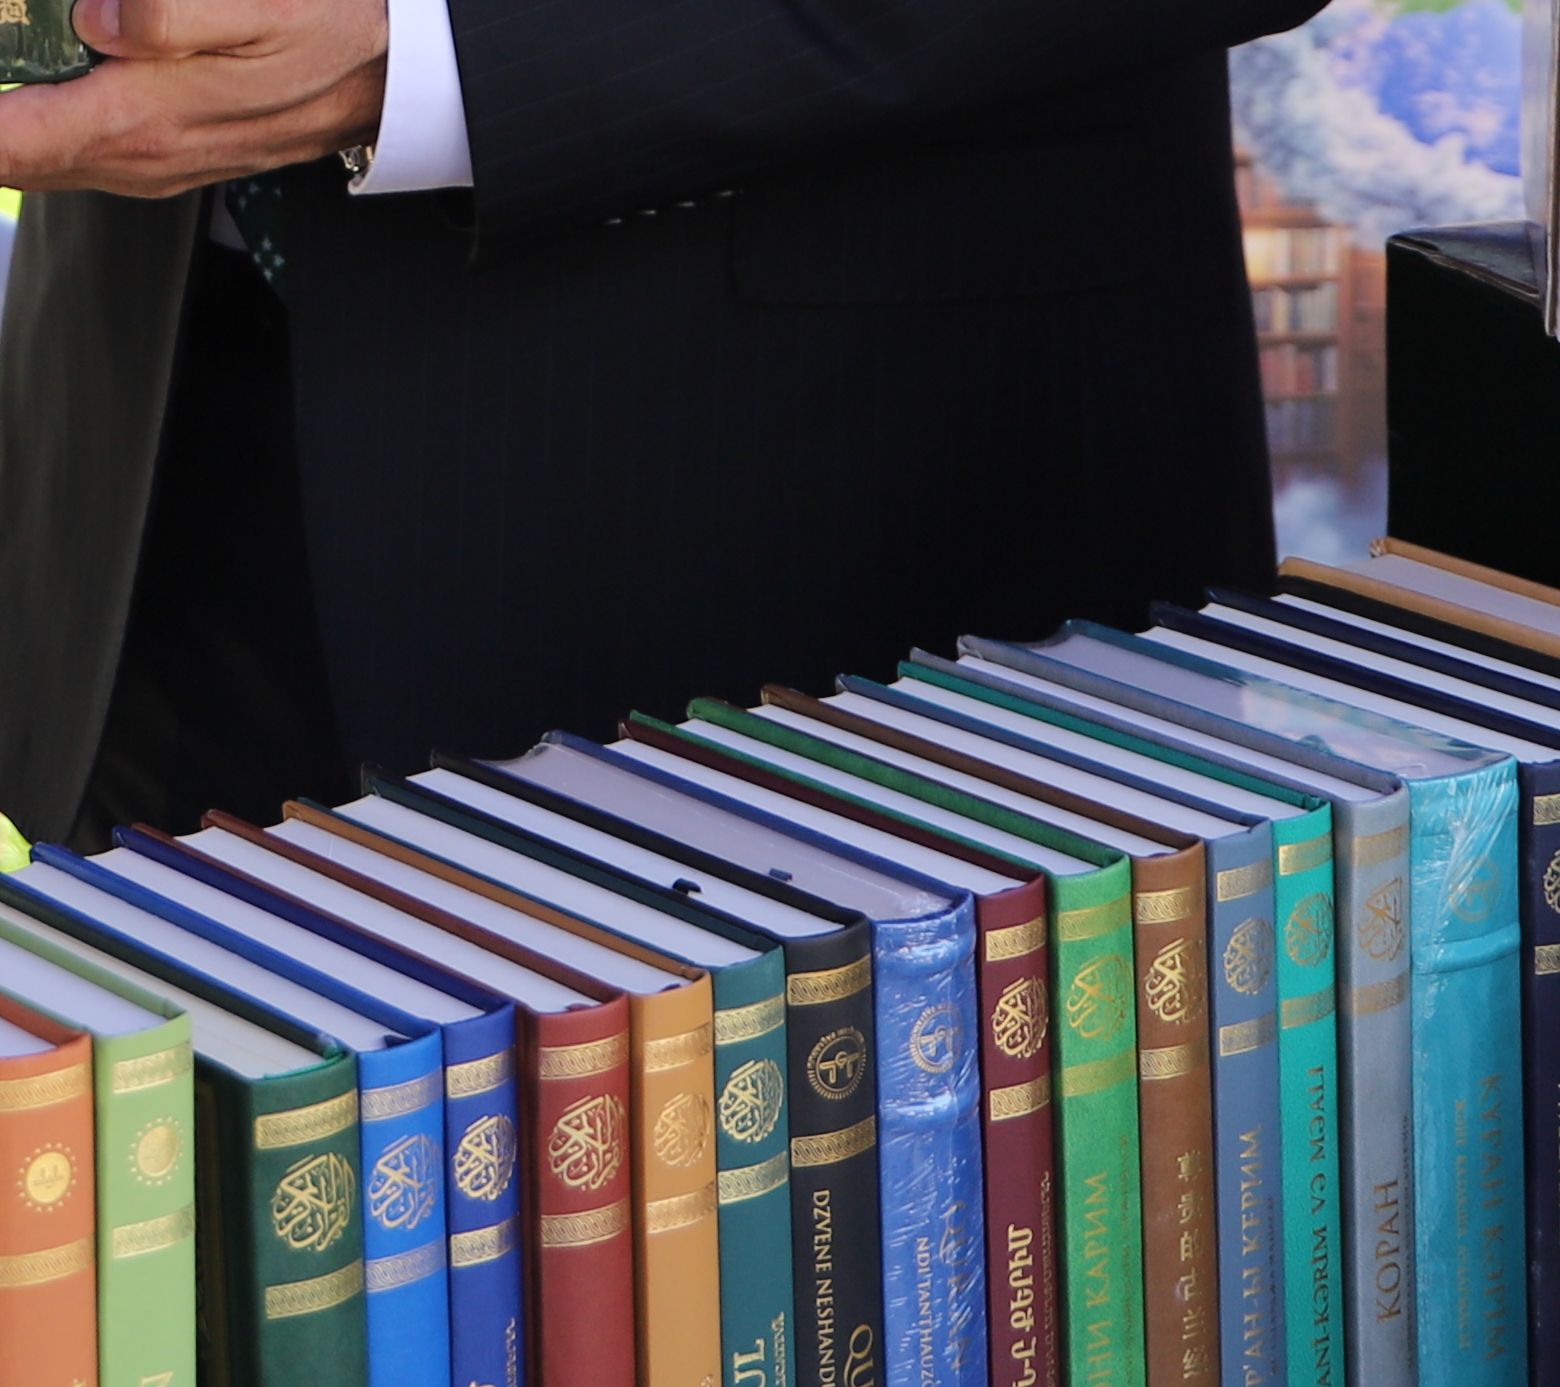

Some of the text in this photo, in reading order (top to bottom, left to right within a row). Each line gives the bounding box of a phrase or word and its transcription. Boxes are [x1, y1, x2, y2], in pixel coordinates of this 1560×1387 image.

[1083, 1172, 1111, 1307] КАРИМ
[1239, 1123, 1266, 1256] КЕРИМ
[1311, 1173, 1326, 1215] VƏ
[1373, 1179, 1402, 1323] КОРАН
[812, 1189, 836, 1387] DZVENE NESHAND
